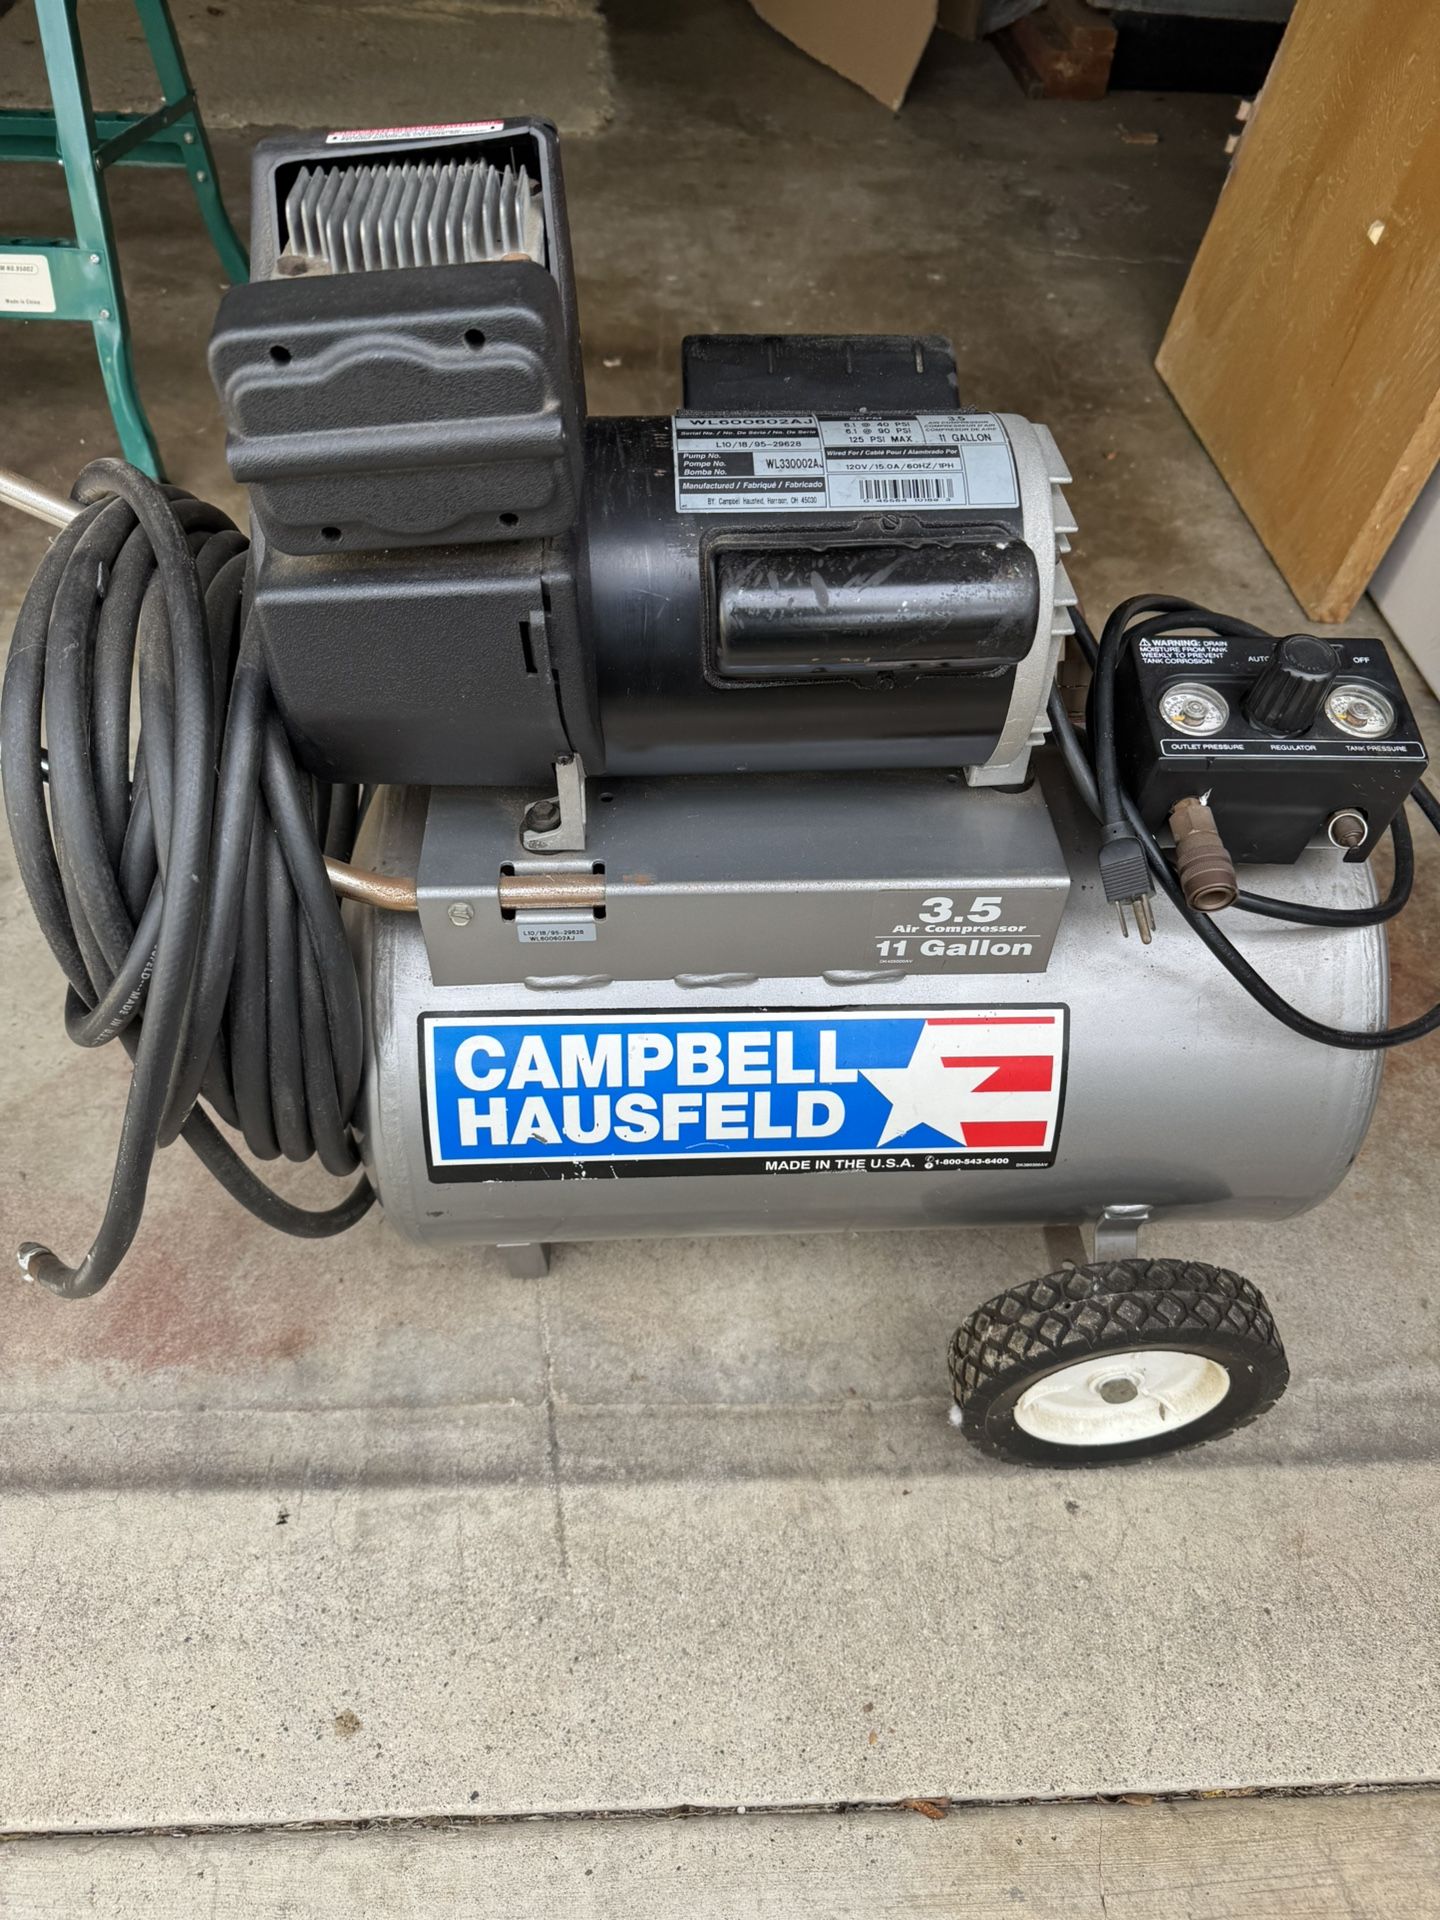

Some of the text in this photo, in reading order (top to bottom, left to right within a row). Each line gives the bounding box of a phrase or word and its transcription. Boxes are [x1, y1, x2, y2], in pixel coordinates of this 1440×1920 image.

[689, 418, 813, 426] WL600602AJ
[891, 435, 914, 443] MAX
[939, 433, 992, 442] 11 GALLON
[716, 440, 802, 449] L10/18/95-29628
[683, 453, 706, 461] Pump
[845, 462, 954, 470] 120V/15.0A/60HZ/1PH
[682, 482, 735, 490] Manufactured
[743, 481, 777, 490] Fabriqué
[784, 480, 823, 489] Fabricado
[1152, 639, 1201, 647] WARNING:
[1352, 656, 1370, 664] OFF
[918, 896, 1003, 924] 3.5
[892, 924, 1027, 935] Air Compressor
[876, 939, 1033, 957] 11 Gallon
[454, 1030, 859, 1092] CAMPBELL
[458, 1090, 846, 1147] HAUSFELD
[765, 1158, 915, 1171] MADE IN THE U.S.A.
[935, 1157, 1010, 1166] 1-800-543-6400
